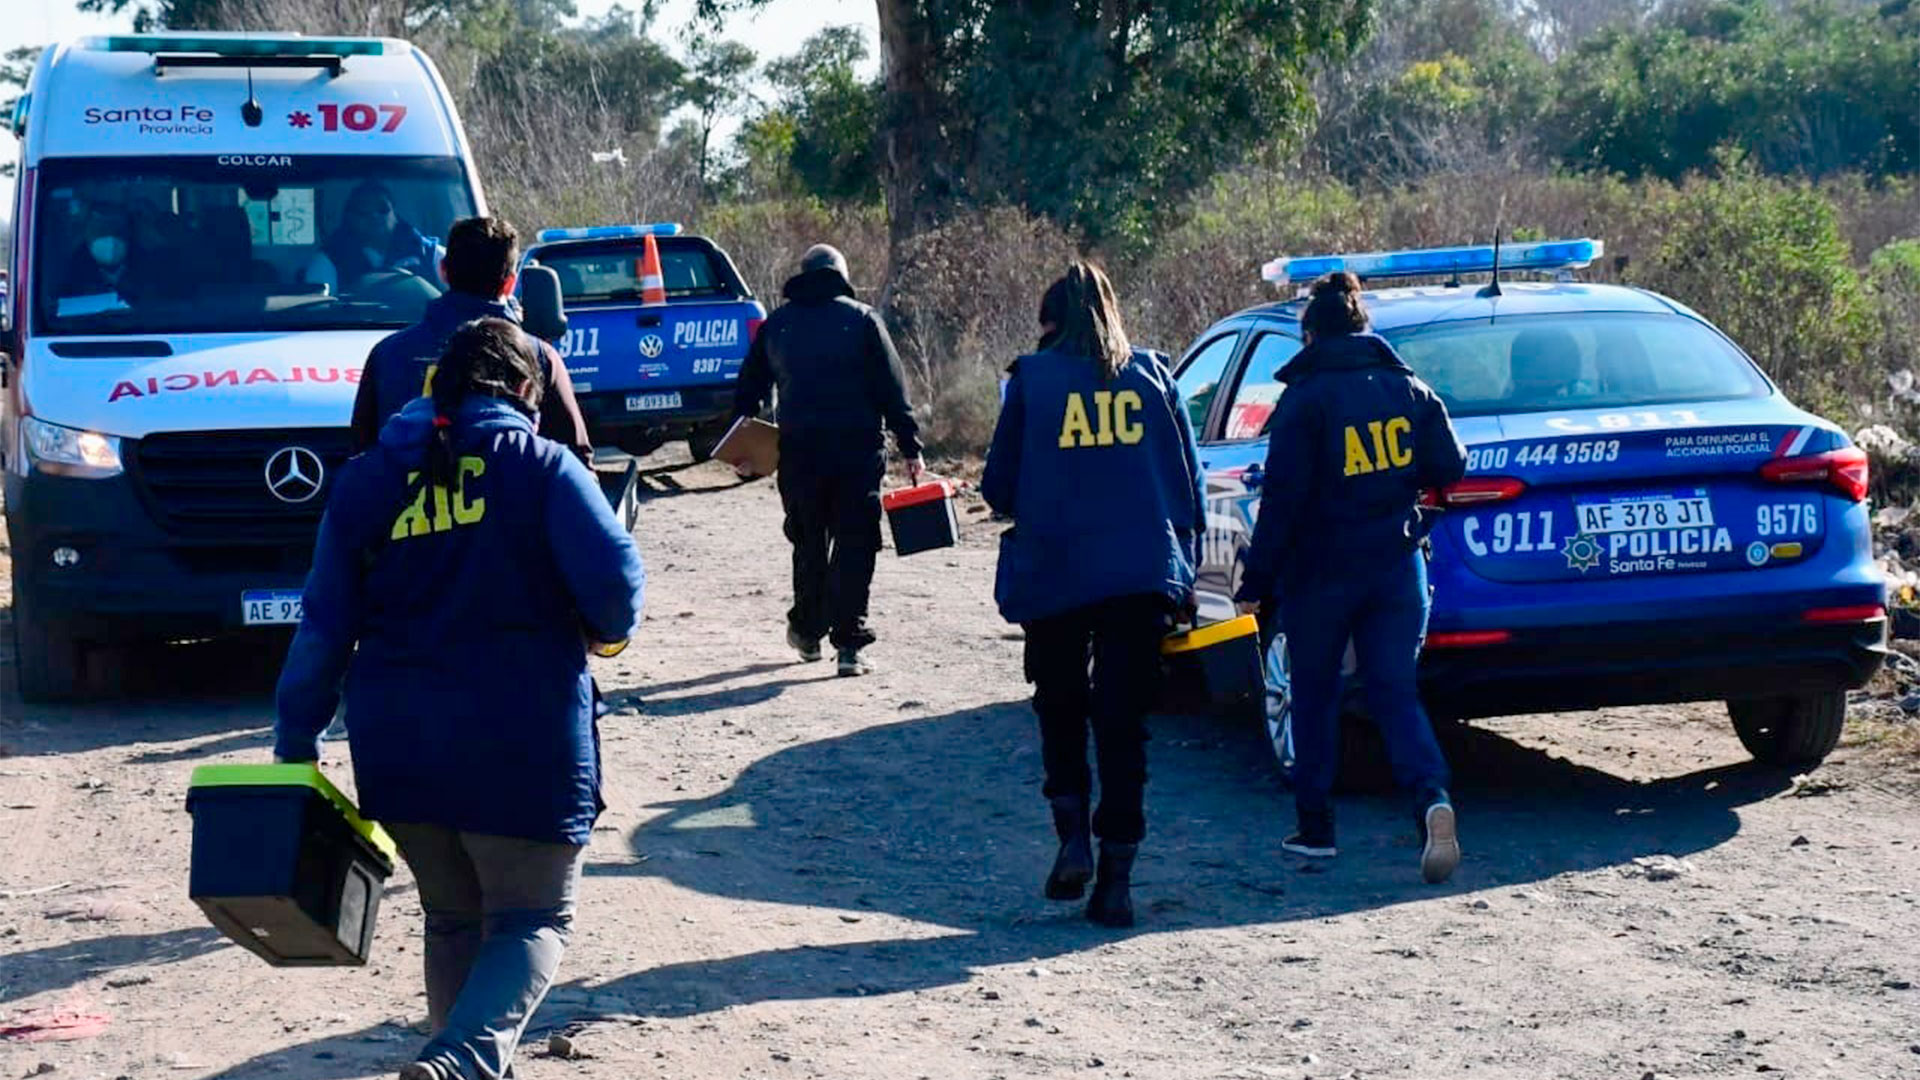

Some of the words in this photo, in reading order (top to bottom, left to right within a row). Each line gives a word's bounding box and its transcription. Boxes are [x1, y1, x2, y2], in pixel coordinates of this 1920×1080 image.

[84, 106, 172, 124] Santa
[181, 105, 213, 122] Fe
[139, 124, 213, 134] Provincia
[217, 155, 292, 166] COLCAR
[559, 328, 600, 358] 911
[673, 319, 738, 344] POLICIA
[1058, 389, 1144, 448] AIC
[1344, 417, 1413, 476] AIC
[1665, 436, 1694, 447] PARA
[1696, 432, 1757, 446] DENUNCIAR
[1759, 431, 1770, 442] EL
[1666, 446, 1724, 457] ACCIONAR
[1726, 443, 1771, 455] POLICIAL
[1514, 444, 1558, 467] 444
[1564, 439, 1620, 464] 3583
[1586, 506, 1613, 530] AF
[1622, 502, 1669, 527] 378
[1677, 500, 1704, 523] JT
[1757, 503, 1817, 536] 9576
[1492, 511, 1556, 553] 911
[1609, 527, 1733, 558] POLICIA
[1609, 559, 1655, 574] Santa
[1657, 556, 1676, 571] Fe
[249, 601, 274, 620] AE
[281, 601, 304, 620] 92
